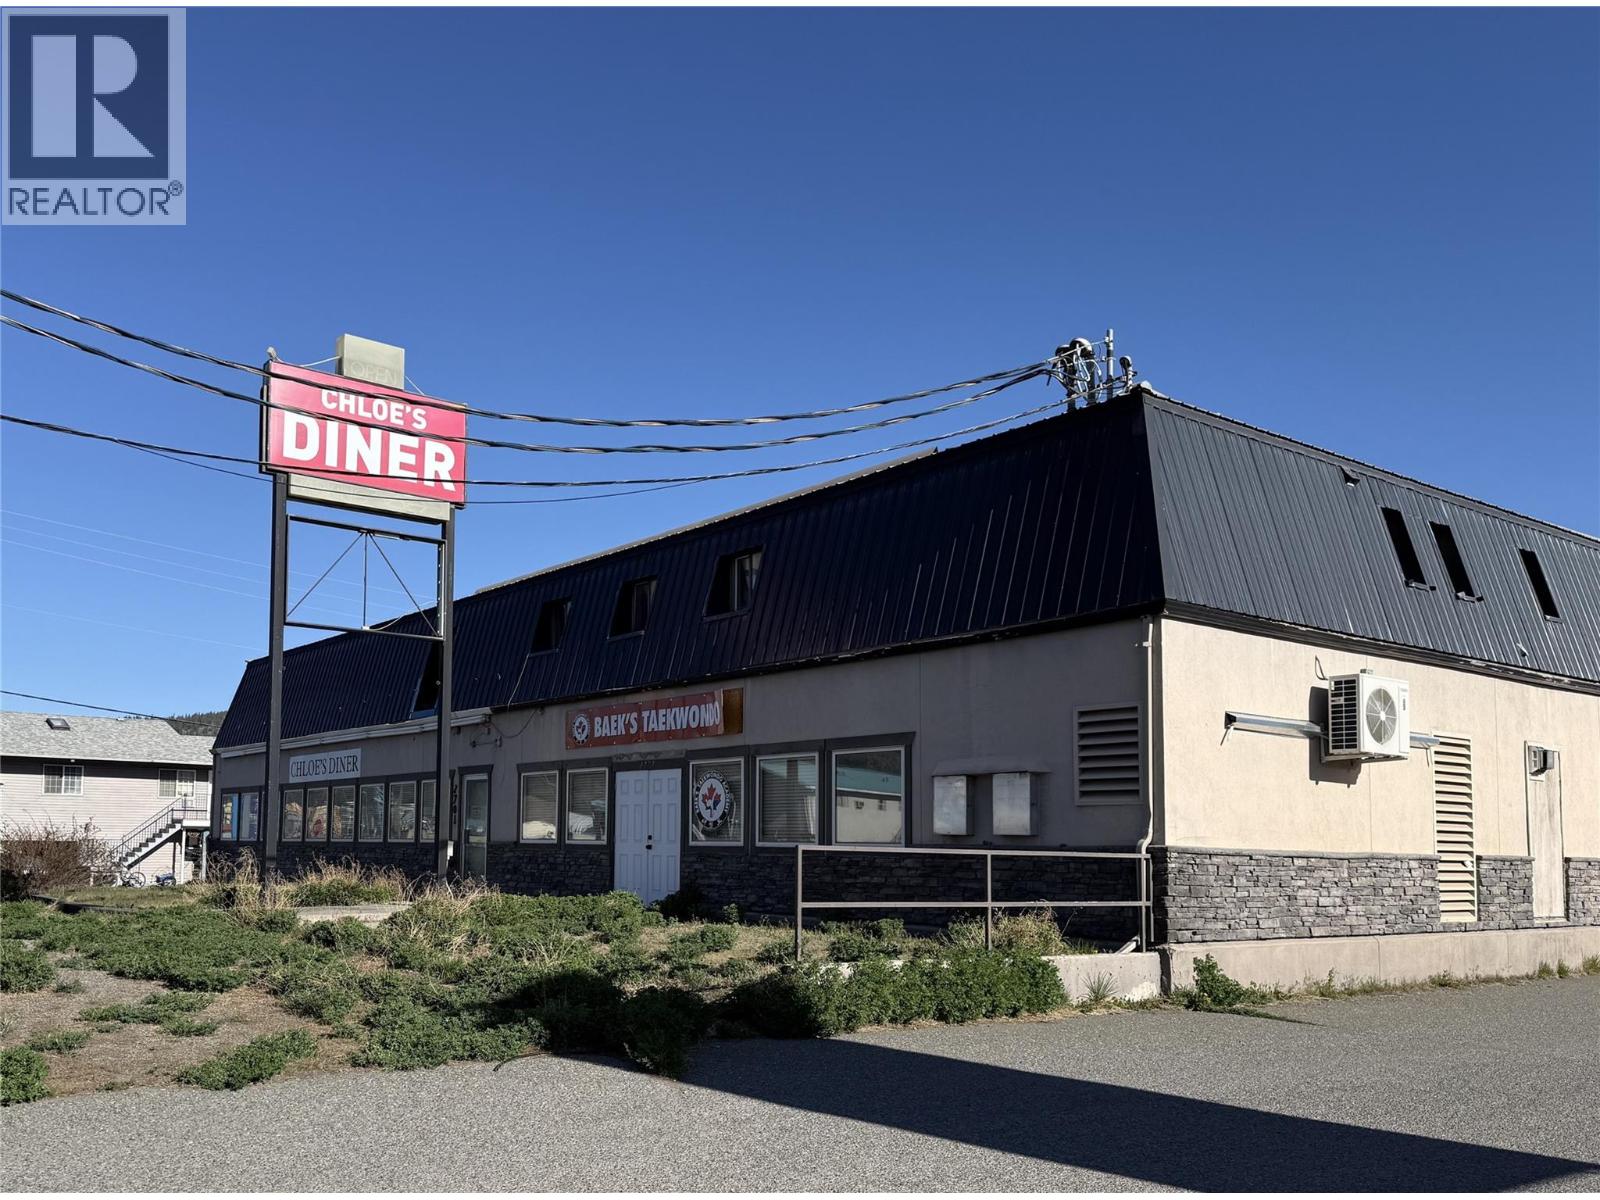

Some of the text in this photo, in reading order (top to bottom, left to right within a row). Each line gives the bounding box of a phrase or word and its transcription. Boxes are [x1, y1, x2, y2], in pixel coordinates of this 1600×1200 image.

[350, 361, 398, 385] OPEN
[321, 388, 427, 430] CHLOE'S
[282, 410, 456, 492] DINER
[593, 712, 638, 738] BAEK'S
[641, 701, 721, 733] TAEKWONDO
[290, 754, 359, 778] CHLOE'S DINER
